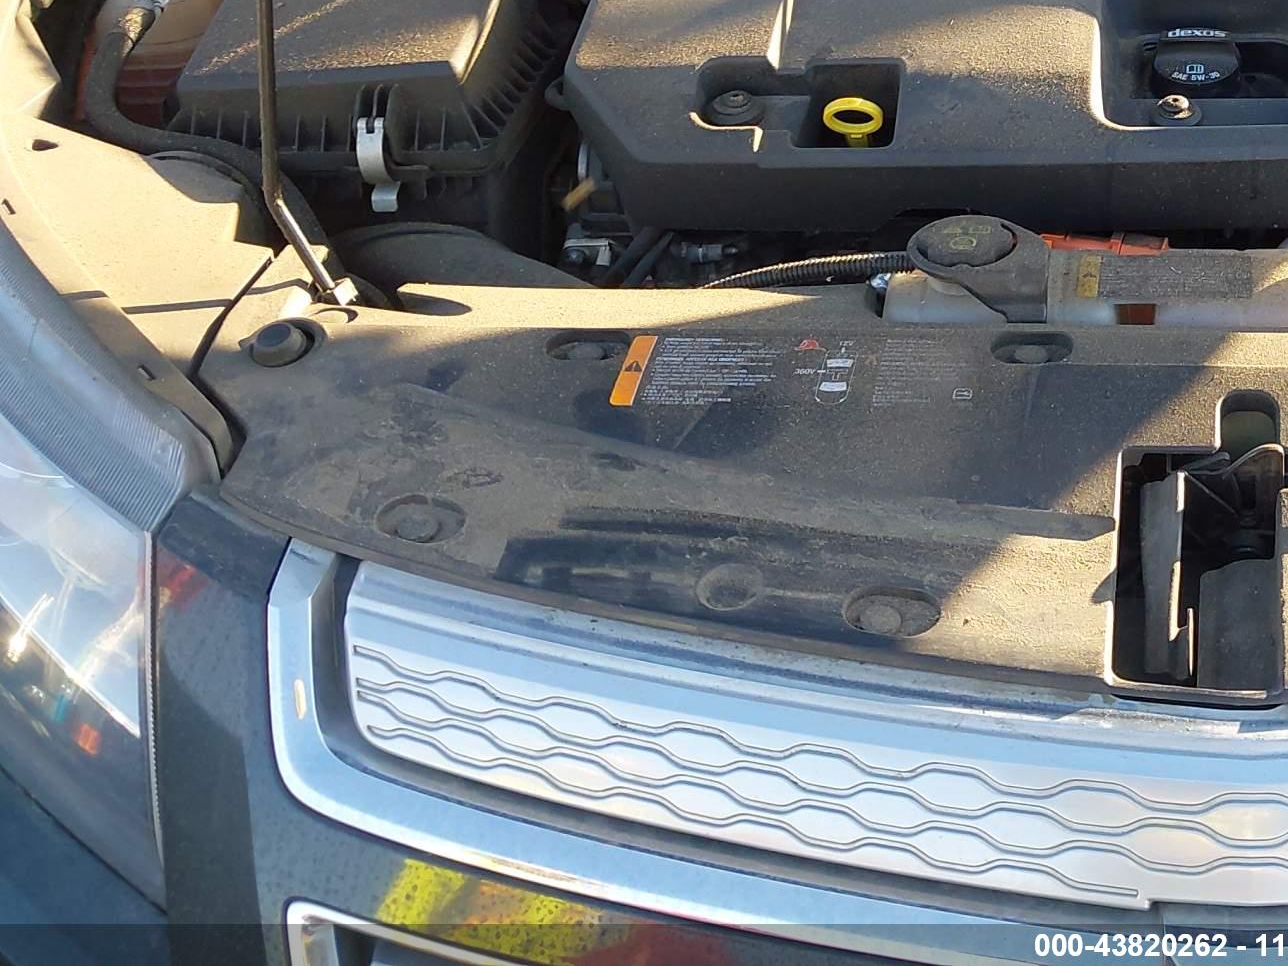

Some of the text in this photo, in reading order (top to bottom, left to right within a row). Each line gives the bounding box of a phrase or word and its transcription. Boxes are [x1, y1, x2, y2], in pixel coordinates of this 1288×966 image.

[1167, 28, 1227, 38] dexos
[1171, 71, 1221, 81] SAE 5W-30
